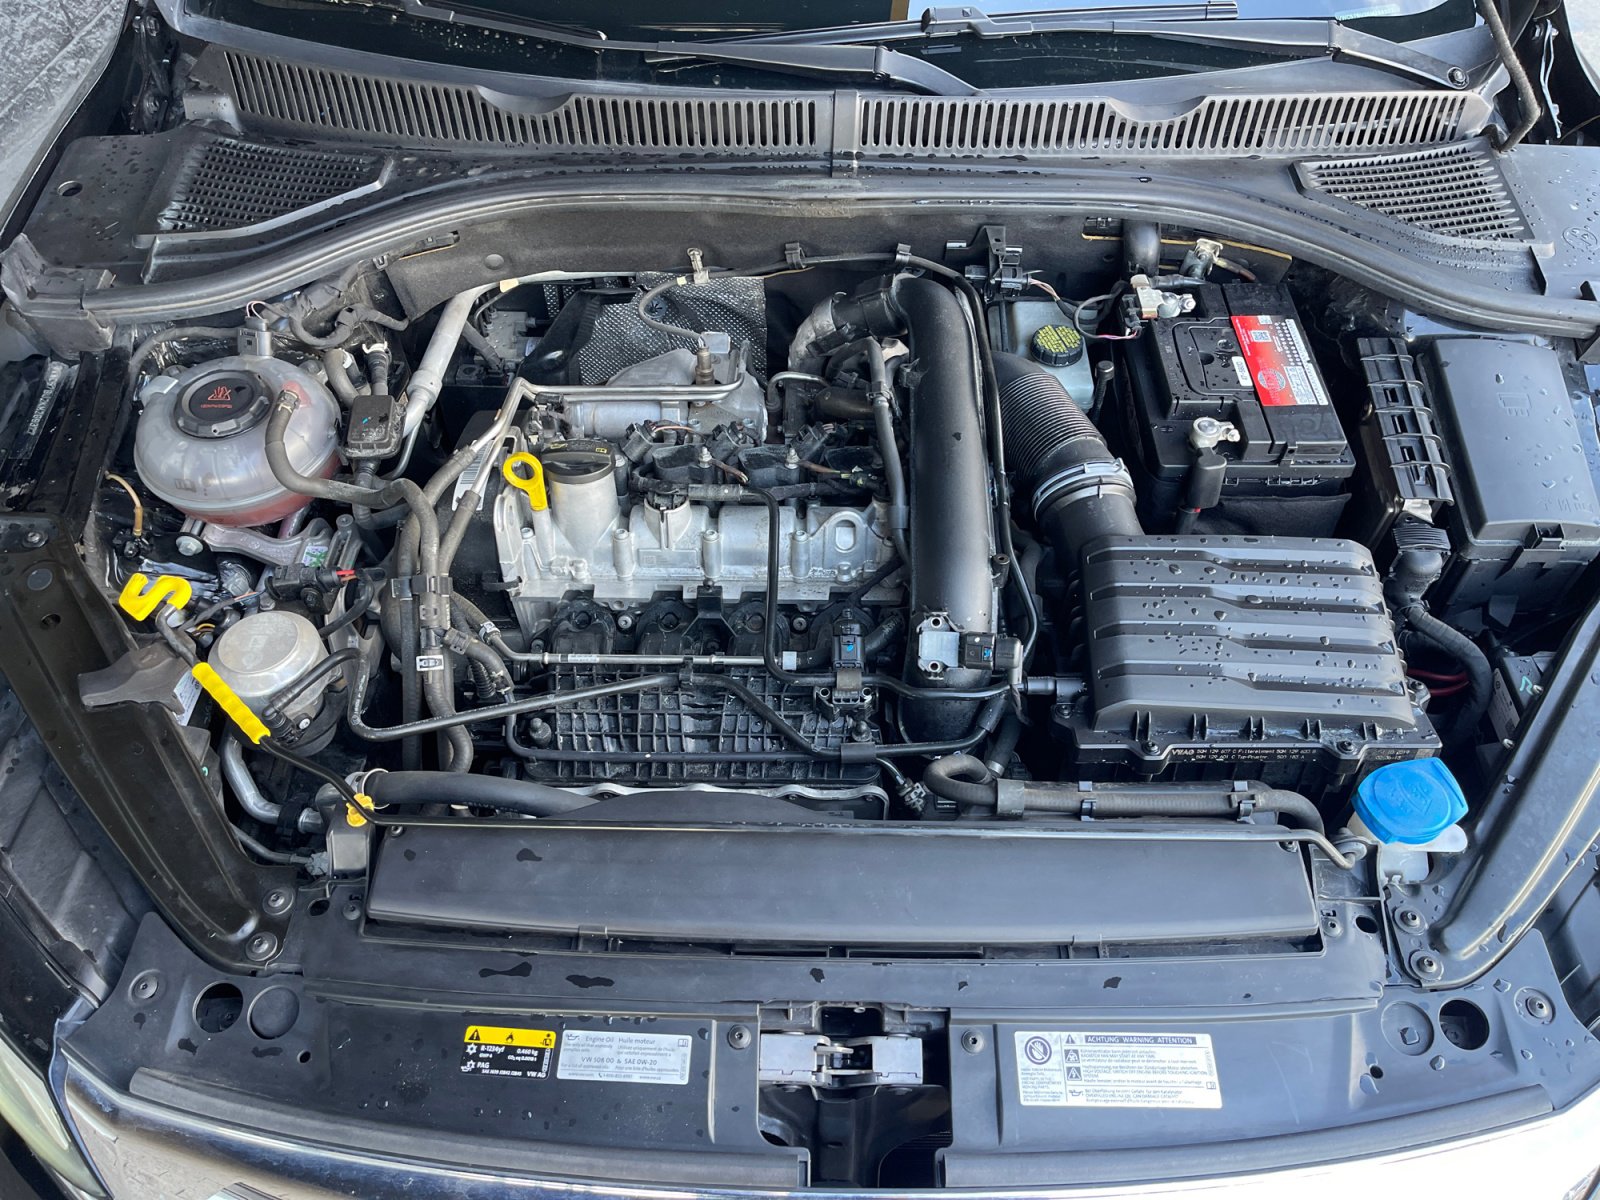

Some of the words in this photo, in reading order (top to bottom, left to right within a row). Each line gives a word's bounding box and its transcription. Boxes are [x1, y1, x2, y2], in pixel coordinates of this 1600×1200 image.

[585, 1036, 606, 1044] Engine
[480, 1045, 506, 1054] R-1234yf
[531, 1049, 539, 1057] kg
[477, 1061, 490, 1069] PAG
[624, 1057, 636, 1065] SAE
[637, 1058, 657, 1066] 0W-20
[526, 1070, 537, 1078] VW
